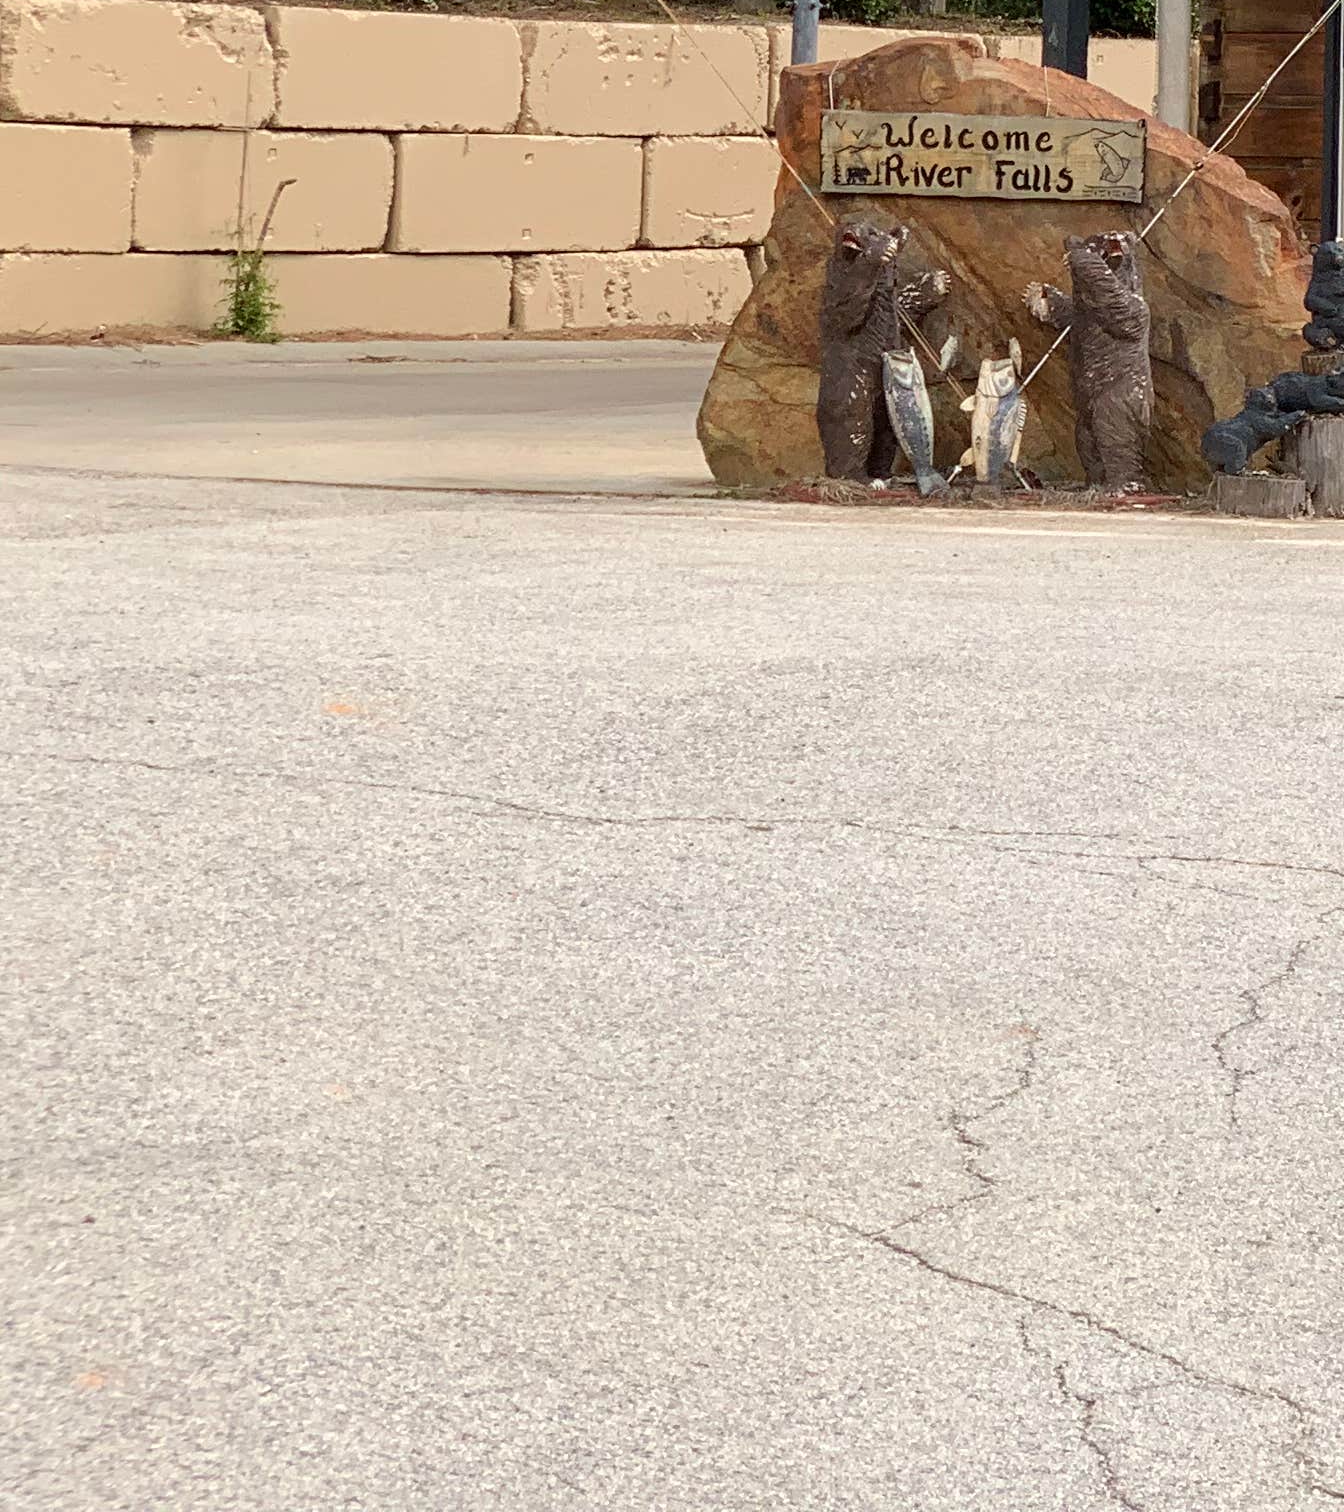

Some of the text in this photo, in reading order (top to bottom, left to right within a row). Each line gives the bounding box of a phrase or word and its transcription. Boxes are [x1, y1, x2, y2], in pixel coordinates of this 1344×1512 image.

[881, 115, 1054, 152] Welcome
[882, 153, 1074, 194] River Falls
